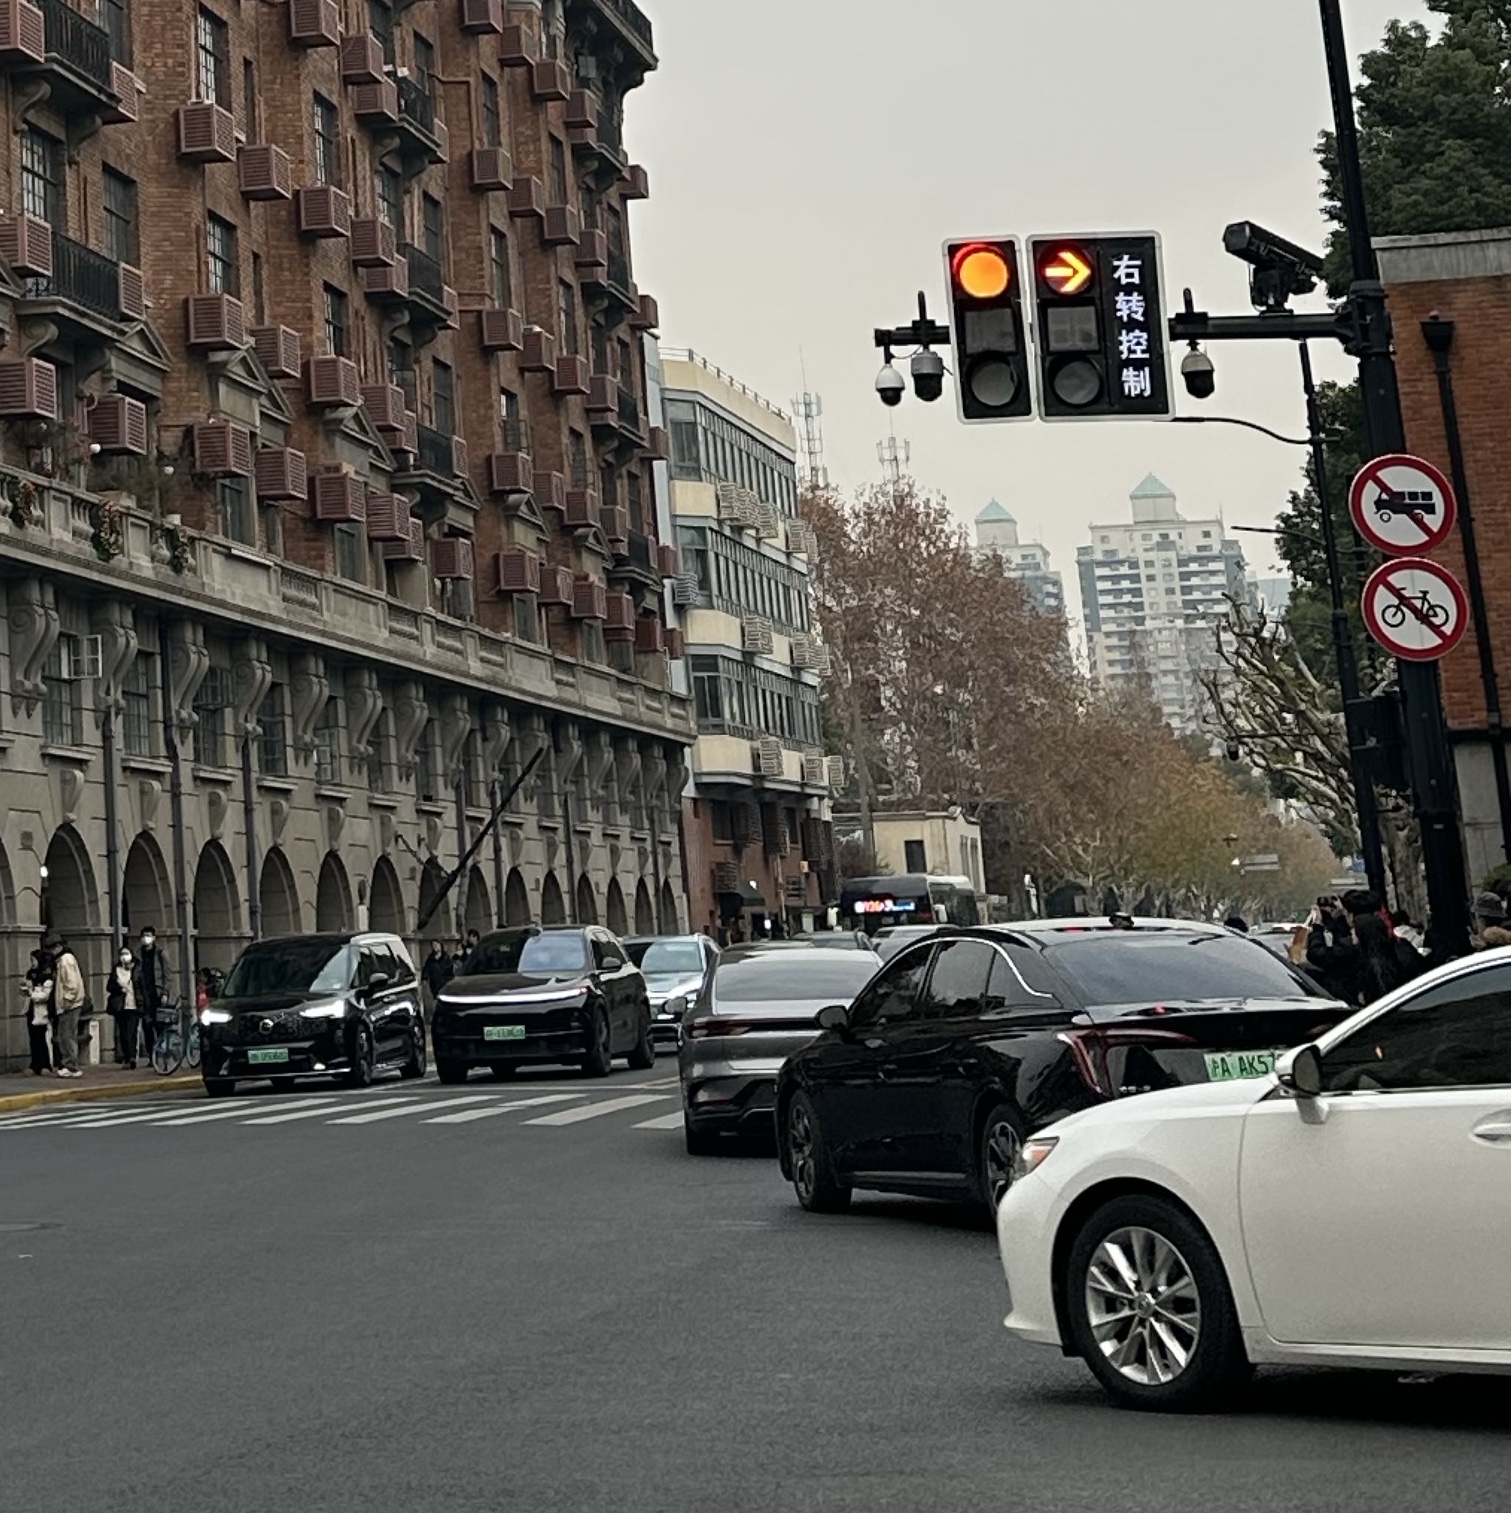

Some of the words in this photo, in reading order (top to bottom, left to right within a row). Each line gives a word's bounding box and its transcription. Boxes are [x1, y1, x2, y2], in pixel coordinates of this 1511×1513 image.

[1112, 254, 1152, 398] 右转控制
[1238, 1052, 1283, 1076] AK57
